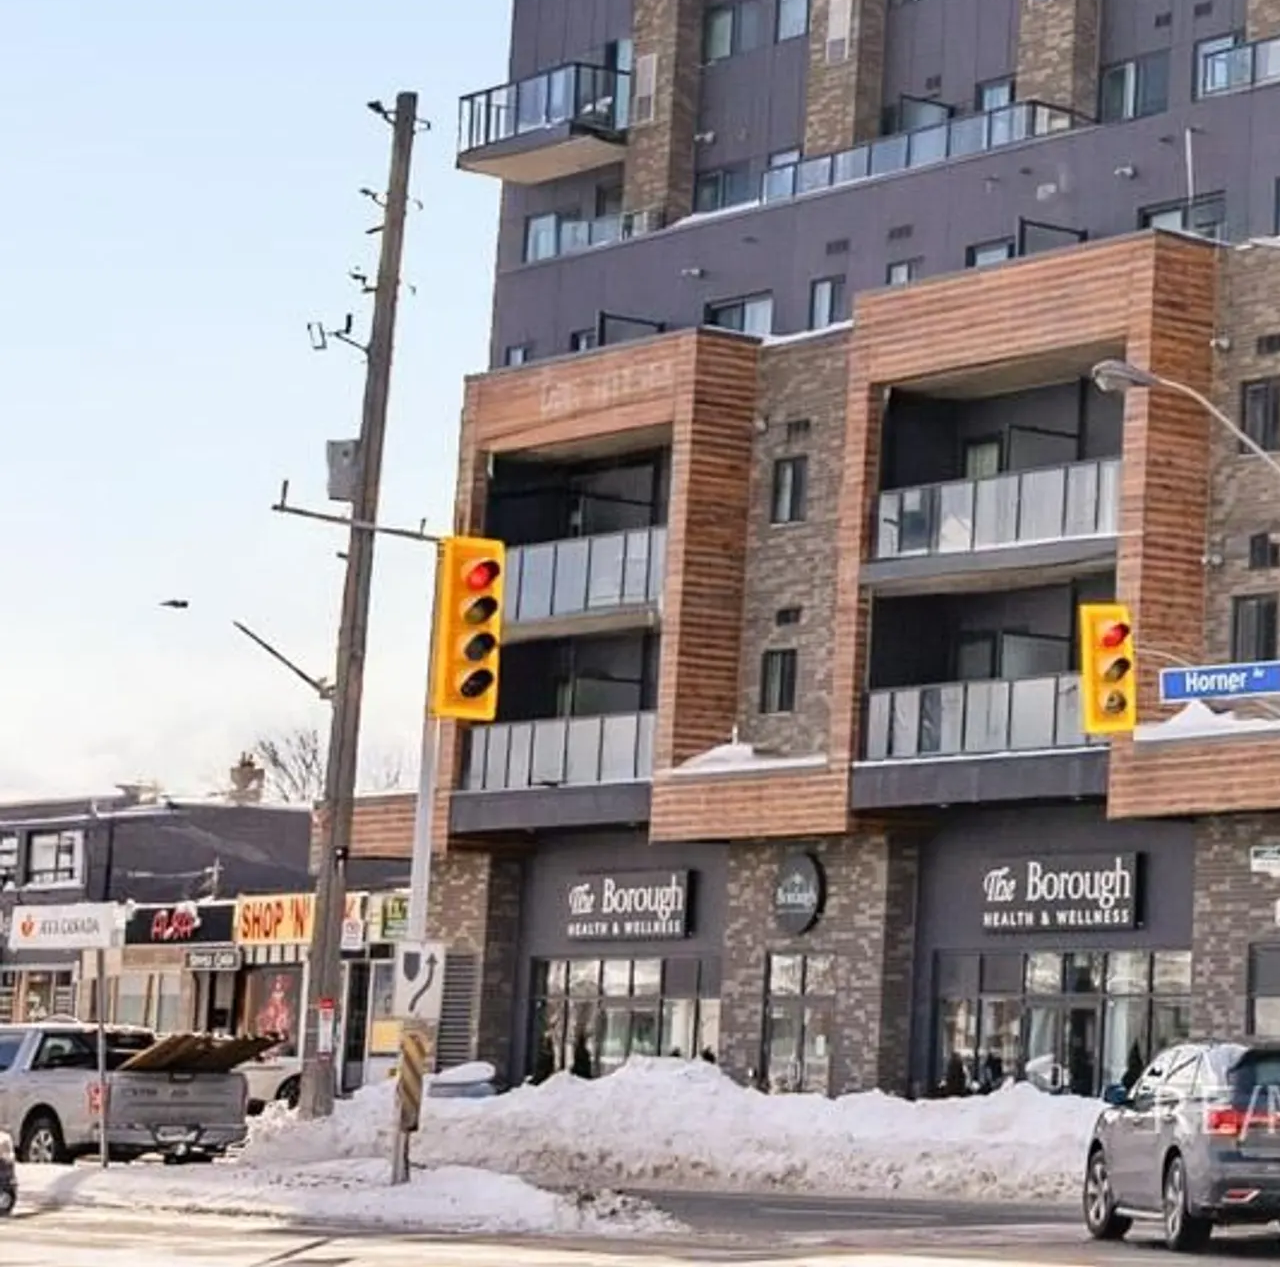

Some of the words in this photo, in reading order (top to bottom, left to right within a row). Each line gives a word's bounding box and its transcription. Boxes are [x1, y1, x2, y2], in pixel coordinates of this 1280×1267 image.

[1184, 671, 1248, 693] Horner
[567, 882, 595, 915] The
[601, 873, 683, 921] Borough
[983, 866, 1016, 902] The
[1025, 856, 1131, 909] Borough
[242, 902, 283, 939] SHOP
[567, 921, 608, 936] HEALTH
[624, 918, 682, 935] WELLNESS
[983, 911, 1034, 928] HEALTH
[1041, 909, 1050, 926] &
[1056, 908, 1130, 926] WELLNESS
